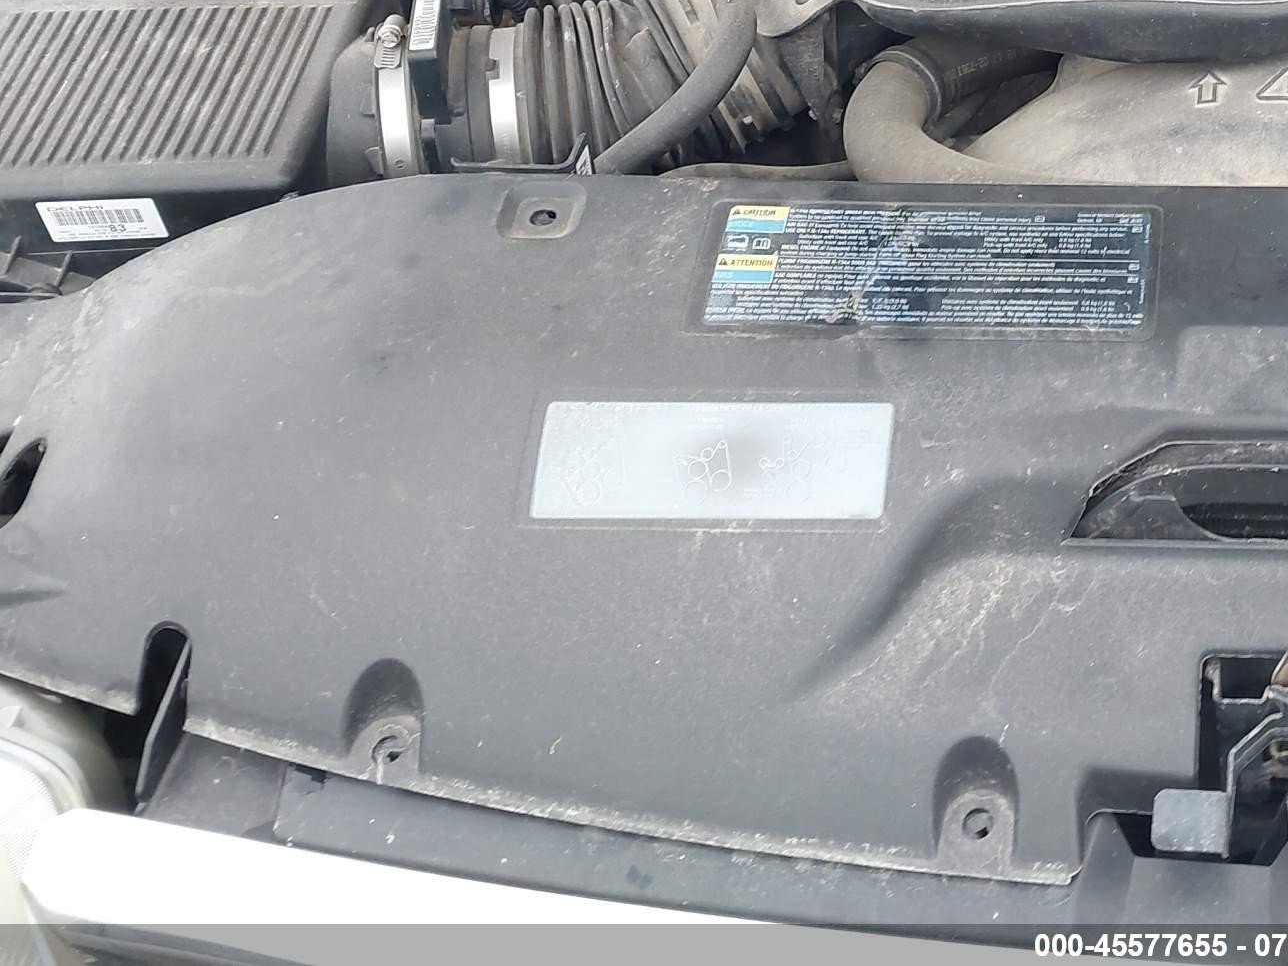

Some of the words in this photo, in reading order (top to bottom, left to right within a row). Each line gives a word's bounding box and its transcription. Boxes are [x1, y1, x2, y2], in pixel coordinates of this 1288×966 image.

[743, 209, 777, 217] CAUTION
[109, 224, 127, 233] 83
[730, 259, 774, 267] ATTENTION
